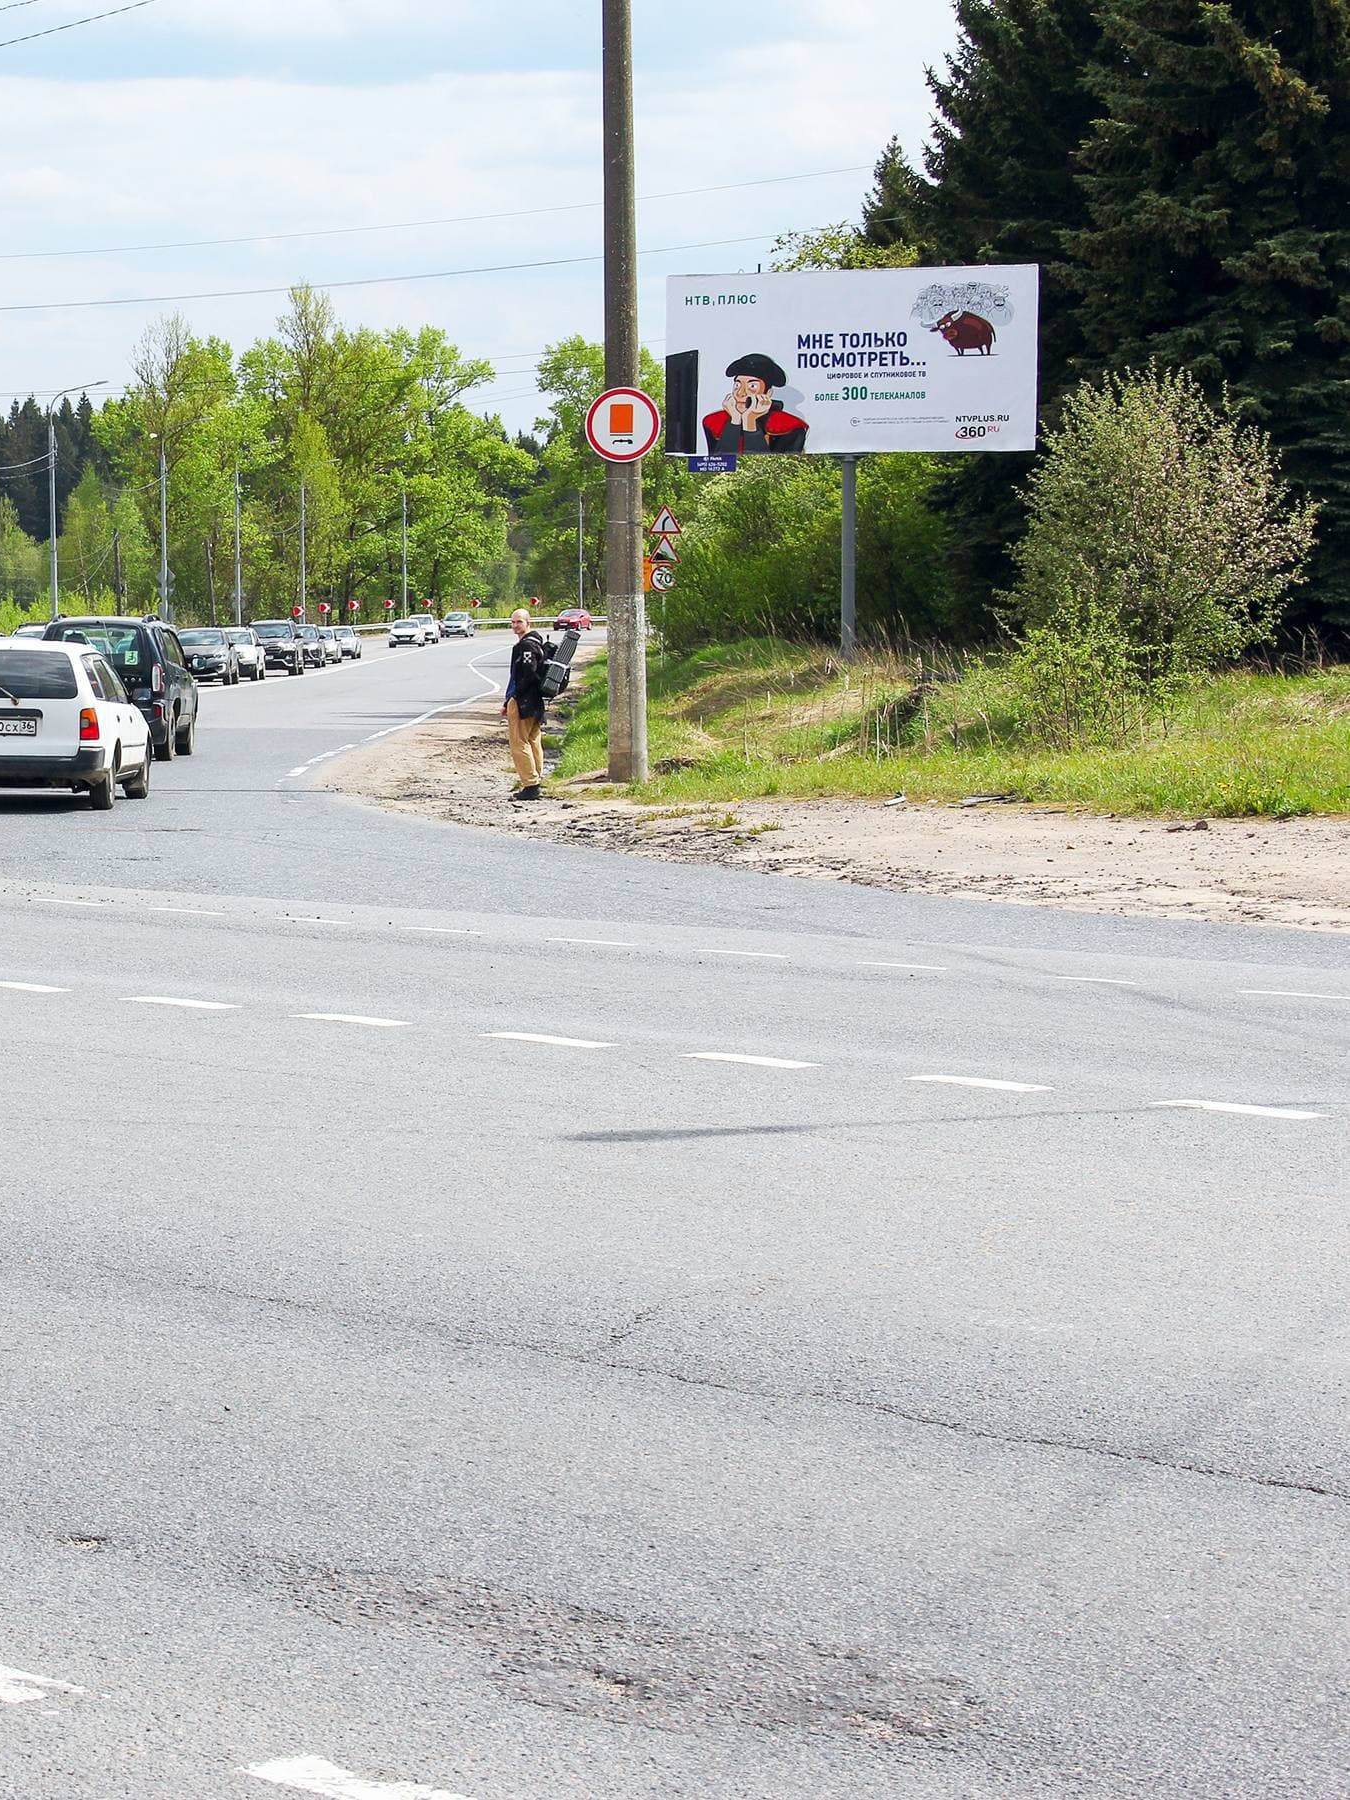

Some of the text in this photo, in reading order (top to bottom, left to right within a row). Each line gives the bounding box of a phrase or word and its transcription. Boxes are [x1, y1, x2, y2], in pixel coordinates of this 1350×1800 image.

[797, 331, 908, 349] МНЕ ТОЛЬКО
[797, 350, 926, 368] ПОСМОТРЕТЬ...
[826, 372, 862, 380] ЦИФРОВОЕ
[918, 370, 927, 378] ТВ
[814, 386, 926, 401] БОЛЕЕ 300 ТЕЛЕКАНАЛОВ
[955, 414, 1010, 423] NTVPLUS.RU
[959, 425, 986, 438] 360
[656, 573, 672, 584] 70
